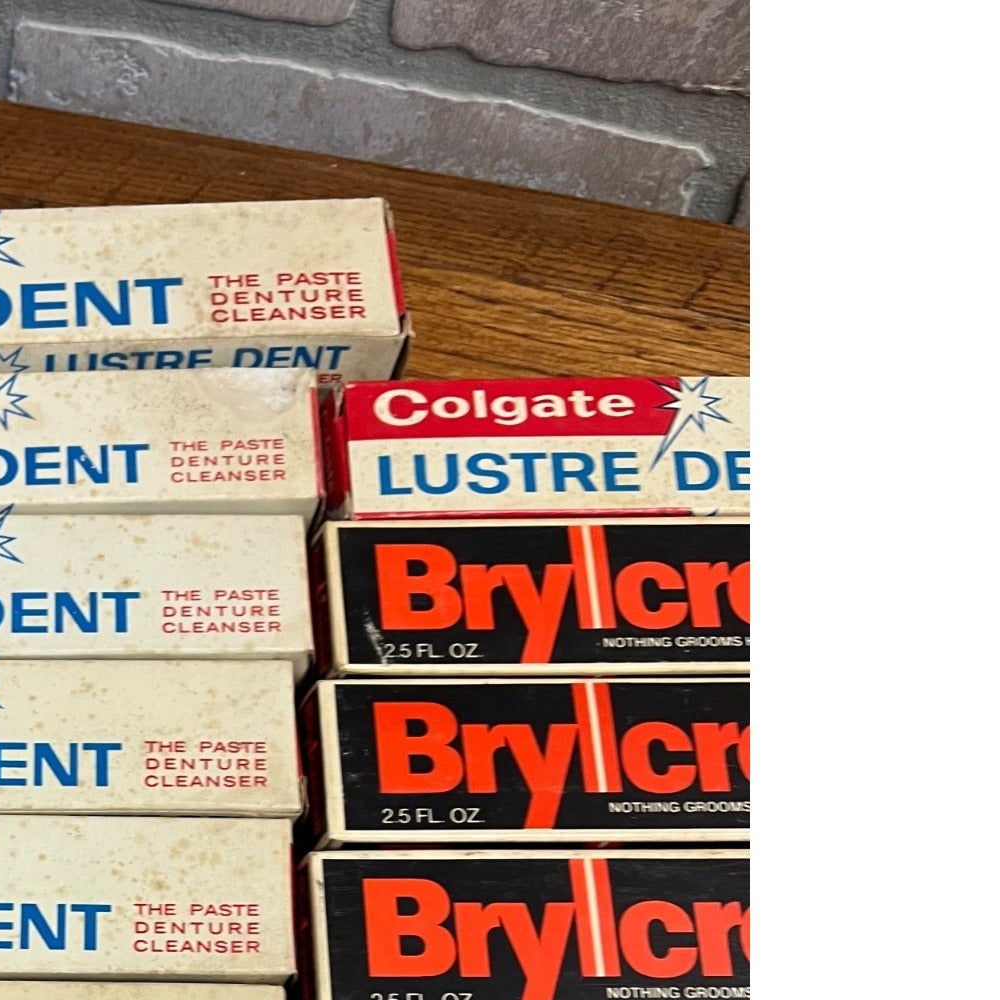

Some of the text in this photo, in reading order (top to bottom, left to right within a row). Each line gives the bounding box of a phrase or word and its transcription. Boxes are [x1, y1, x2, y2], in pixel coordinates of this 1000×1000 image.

[208, 272, 362, 288] THE PASTE
[211, 289, 365, 305] DENTURE
[211, 306, 366, 323] CLEANSER
[373, 388, 636, 427] Colgate
[169, 438, 285, 452] THE PASTE
[170, 454, 285, 468] DENTURE
[170, 469, 286, 484] CLEANSER
[377, 451, 640, 496] LUSTRE
[161, 589, 280, 601] THE PASTE
[162, 605, 281, 618] DENTURE
[162, 620, 281, 634] CLEANSER
[603, 637, 673, 648] NOTHING
[144, 741, 267, 754] THE PASTE
[373, 683, 750, 829] Brylcr
[146, 758, 267, 771] DENTURE
[144, 775, 267, 788] CLEANSER
[609, 801, 680, 813] NOTHING
[133, 903, 260, 917] THE PASTE
[135, 921, 260, 935] DENTURE
[133, 939, 261, 954] CLEANSER
[606, 986, 680, 999] NOTHING
